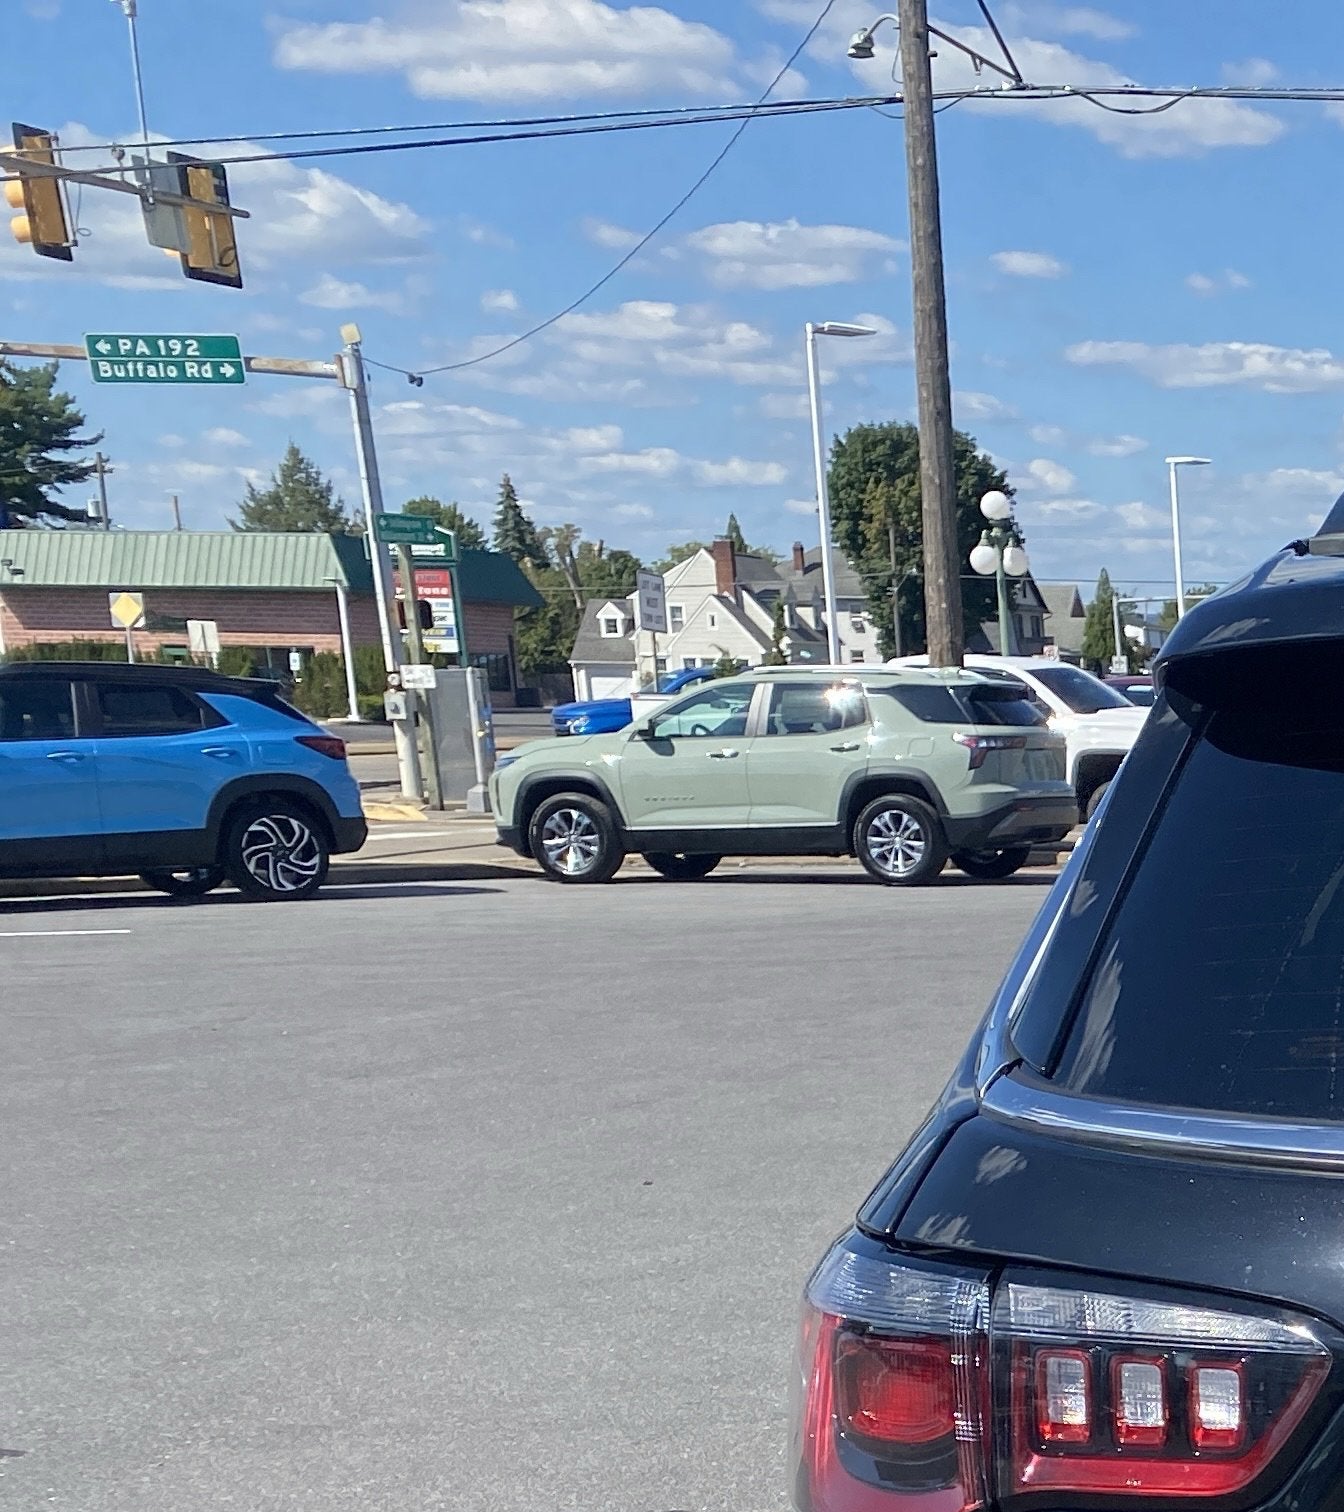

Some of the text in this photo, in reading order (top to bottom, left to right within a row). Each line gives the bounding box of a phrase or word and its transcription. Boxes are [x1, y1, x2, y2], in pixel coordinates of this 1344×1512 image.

[118, 338, 200, 356] PA 192
[98, 361, 213, 378] Buffalo Rd
